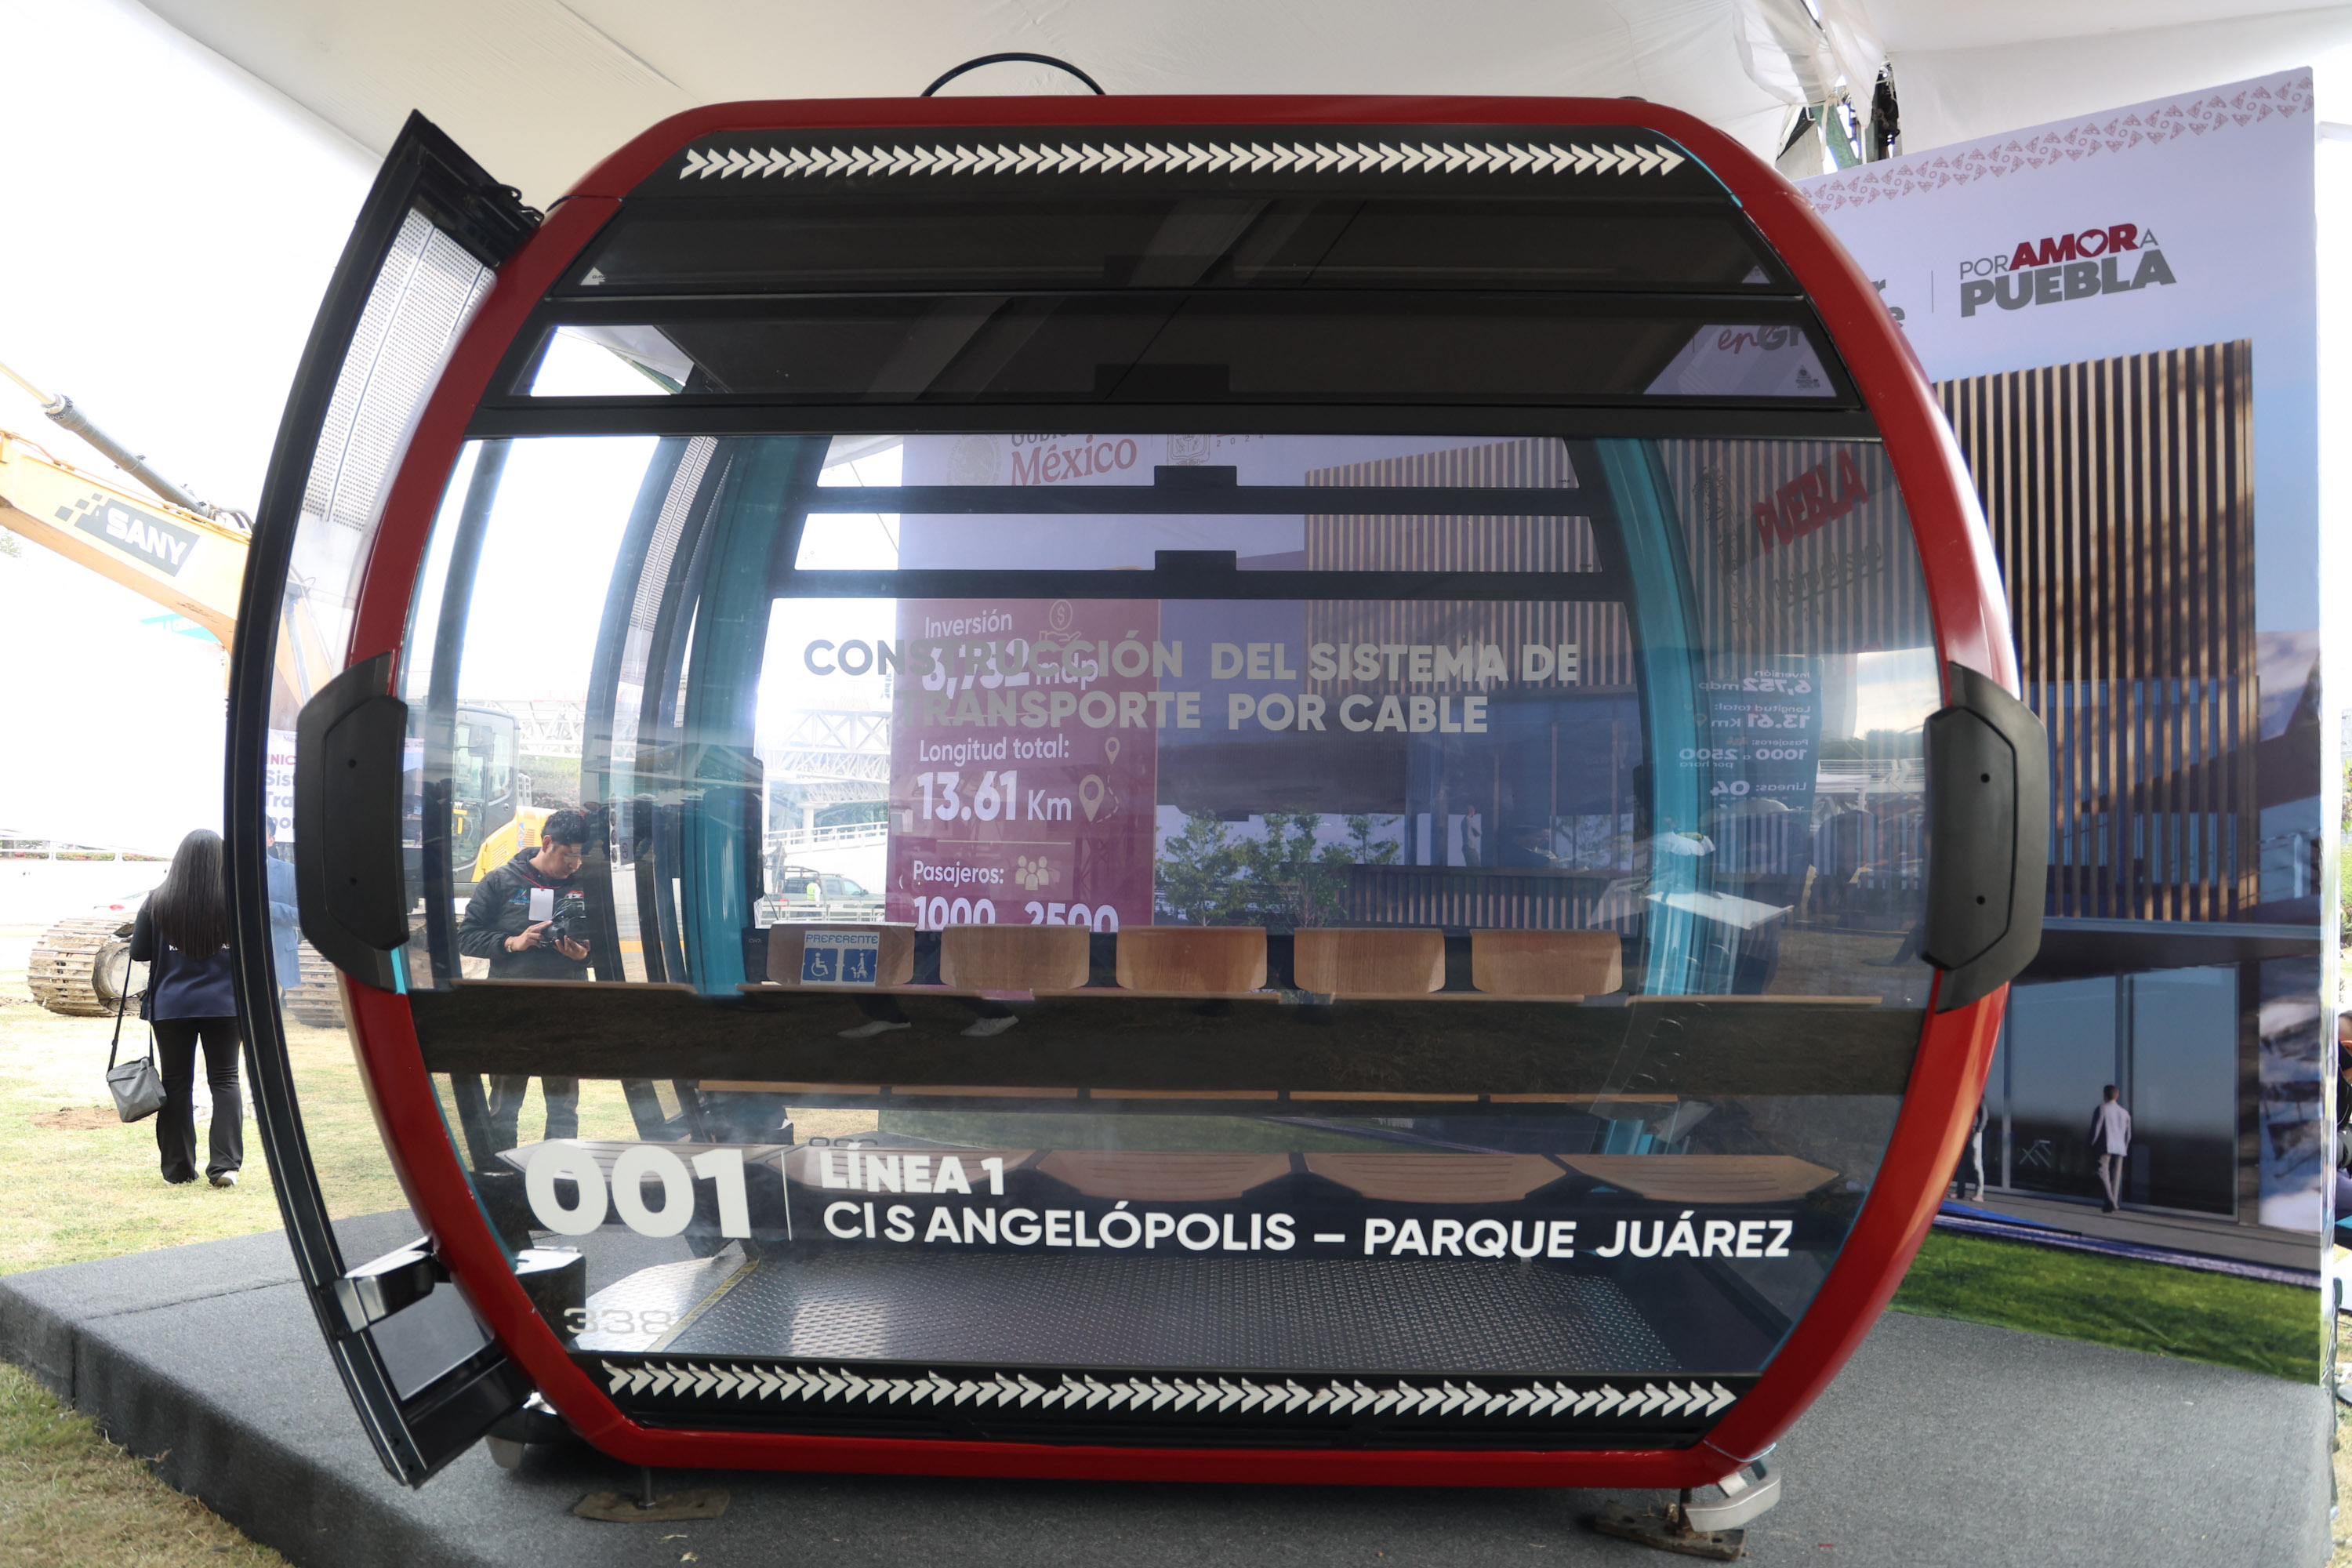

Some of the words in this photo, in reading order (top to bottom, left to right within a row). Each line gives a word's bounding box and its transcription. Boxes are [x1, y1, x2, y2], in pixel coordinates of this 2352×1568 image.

[1960, 255, 2009, 280] POR
[2009, 223, 2140, 270] AMOR
[2140, 228, 2159, 249] A
[1960, 249, 2176, 318] PUEBLA
[1011, 434, 1137, 485] México
[1753, 448, 1870, 555] PUEBLA
[105, 506, 188, 565] SANY
[925, 608, 1013, 638] Inversión
[804, 630, 1182, 678] CONSTRUCCIÓN
[1211, 642, 1297, 680] DEL
[1308, 642, 1509, 682] SISTEMA
[1523, 644, 1577, 682] DE
[895, 690, 1200, 729] TRANSPORTE
[1229, 692, 1327, 731] POR
[1339, 694, 1488, 732] CABLE
[920, 736, 1007, 767] Longitud
[1013, 733, 1069, 759] total:
[916, 770, 1018, 822] 13.61
[1028, 789, 1072, 821] Km
[913, 859, 1004, 887] Pasajeros:
[805, 934, 879, 944] PREFERENTE
[913, 896, 996, 931] 1000
[525, 1145, 751, 1239] 001
[820, 1142, 972, 1194] LÍNEA
[980, 1157, 1004, 1196] 1
[924, 1200, 1296, 1249] ANGELÓPOLIS
[1364, 1217, 1577, 1258] PARQUE
[1596, 1210, 1793, 1258] JUÁREZ
[564, 1307, 672, 1334] 338
